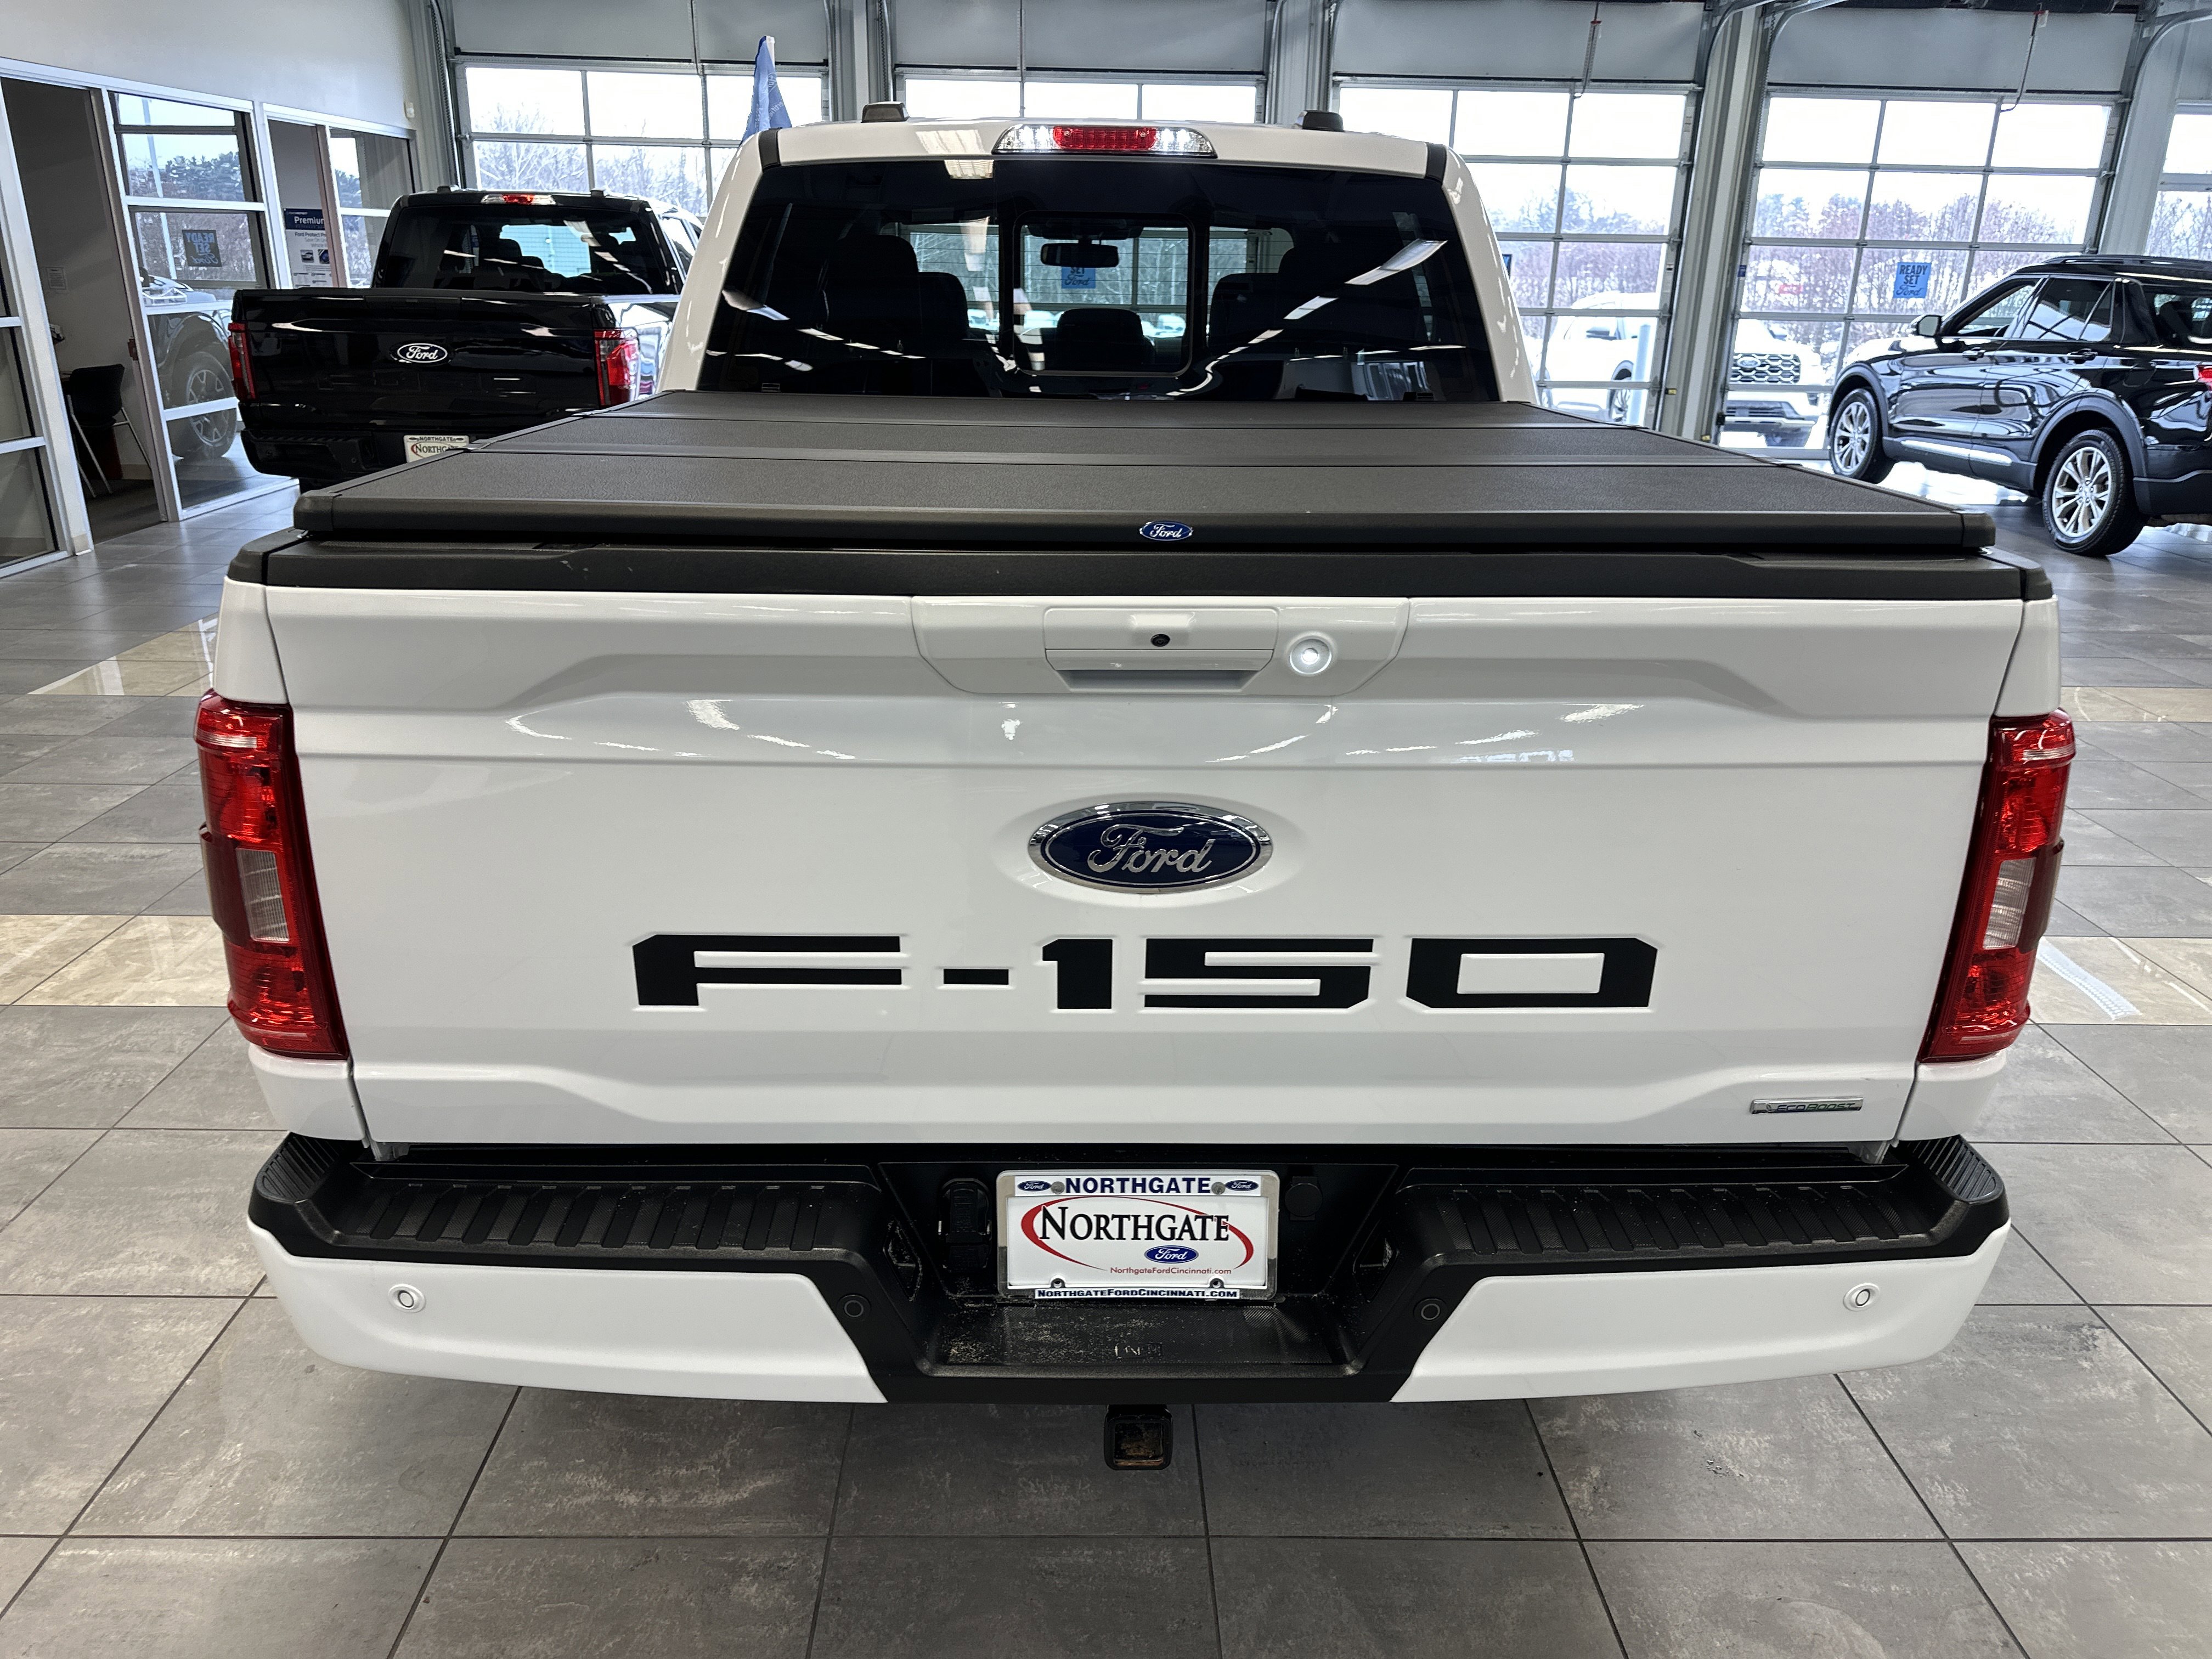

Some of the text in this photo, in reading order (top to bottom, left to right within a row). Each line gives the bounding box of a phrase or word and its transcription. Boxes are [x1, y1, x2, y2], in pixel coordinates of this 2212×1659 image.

[1899, 265, 1927, 275] READY
[1065, 275, 1090, 285] Ford
[1904, 275, 1920, 284] SET
[1896, 285, 1923, 295] Ford
[406, 346, 438, 359] Ford
[1150, 523, 1183, 537] Ford
[1087, 824, 1216, 873] Ford
[633, 934, 1658, 1010] F-150
[1066, 1177, 1211, 1194] NORTHGATE
[1232, 1181, 1251, 1189] Ford
[1040, 1206, 1229, 1242] NORTHGATE
[1154, 1248, 1188, 1260] Ford
[1110, 1267, 1232, 1276] NorthgateFordCincinnati.com
[1038, 1289, 1237, 1297] NORTHGATEFORDCINCINNATI.COM
